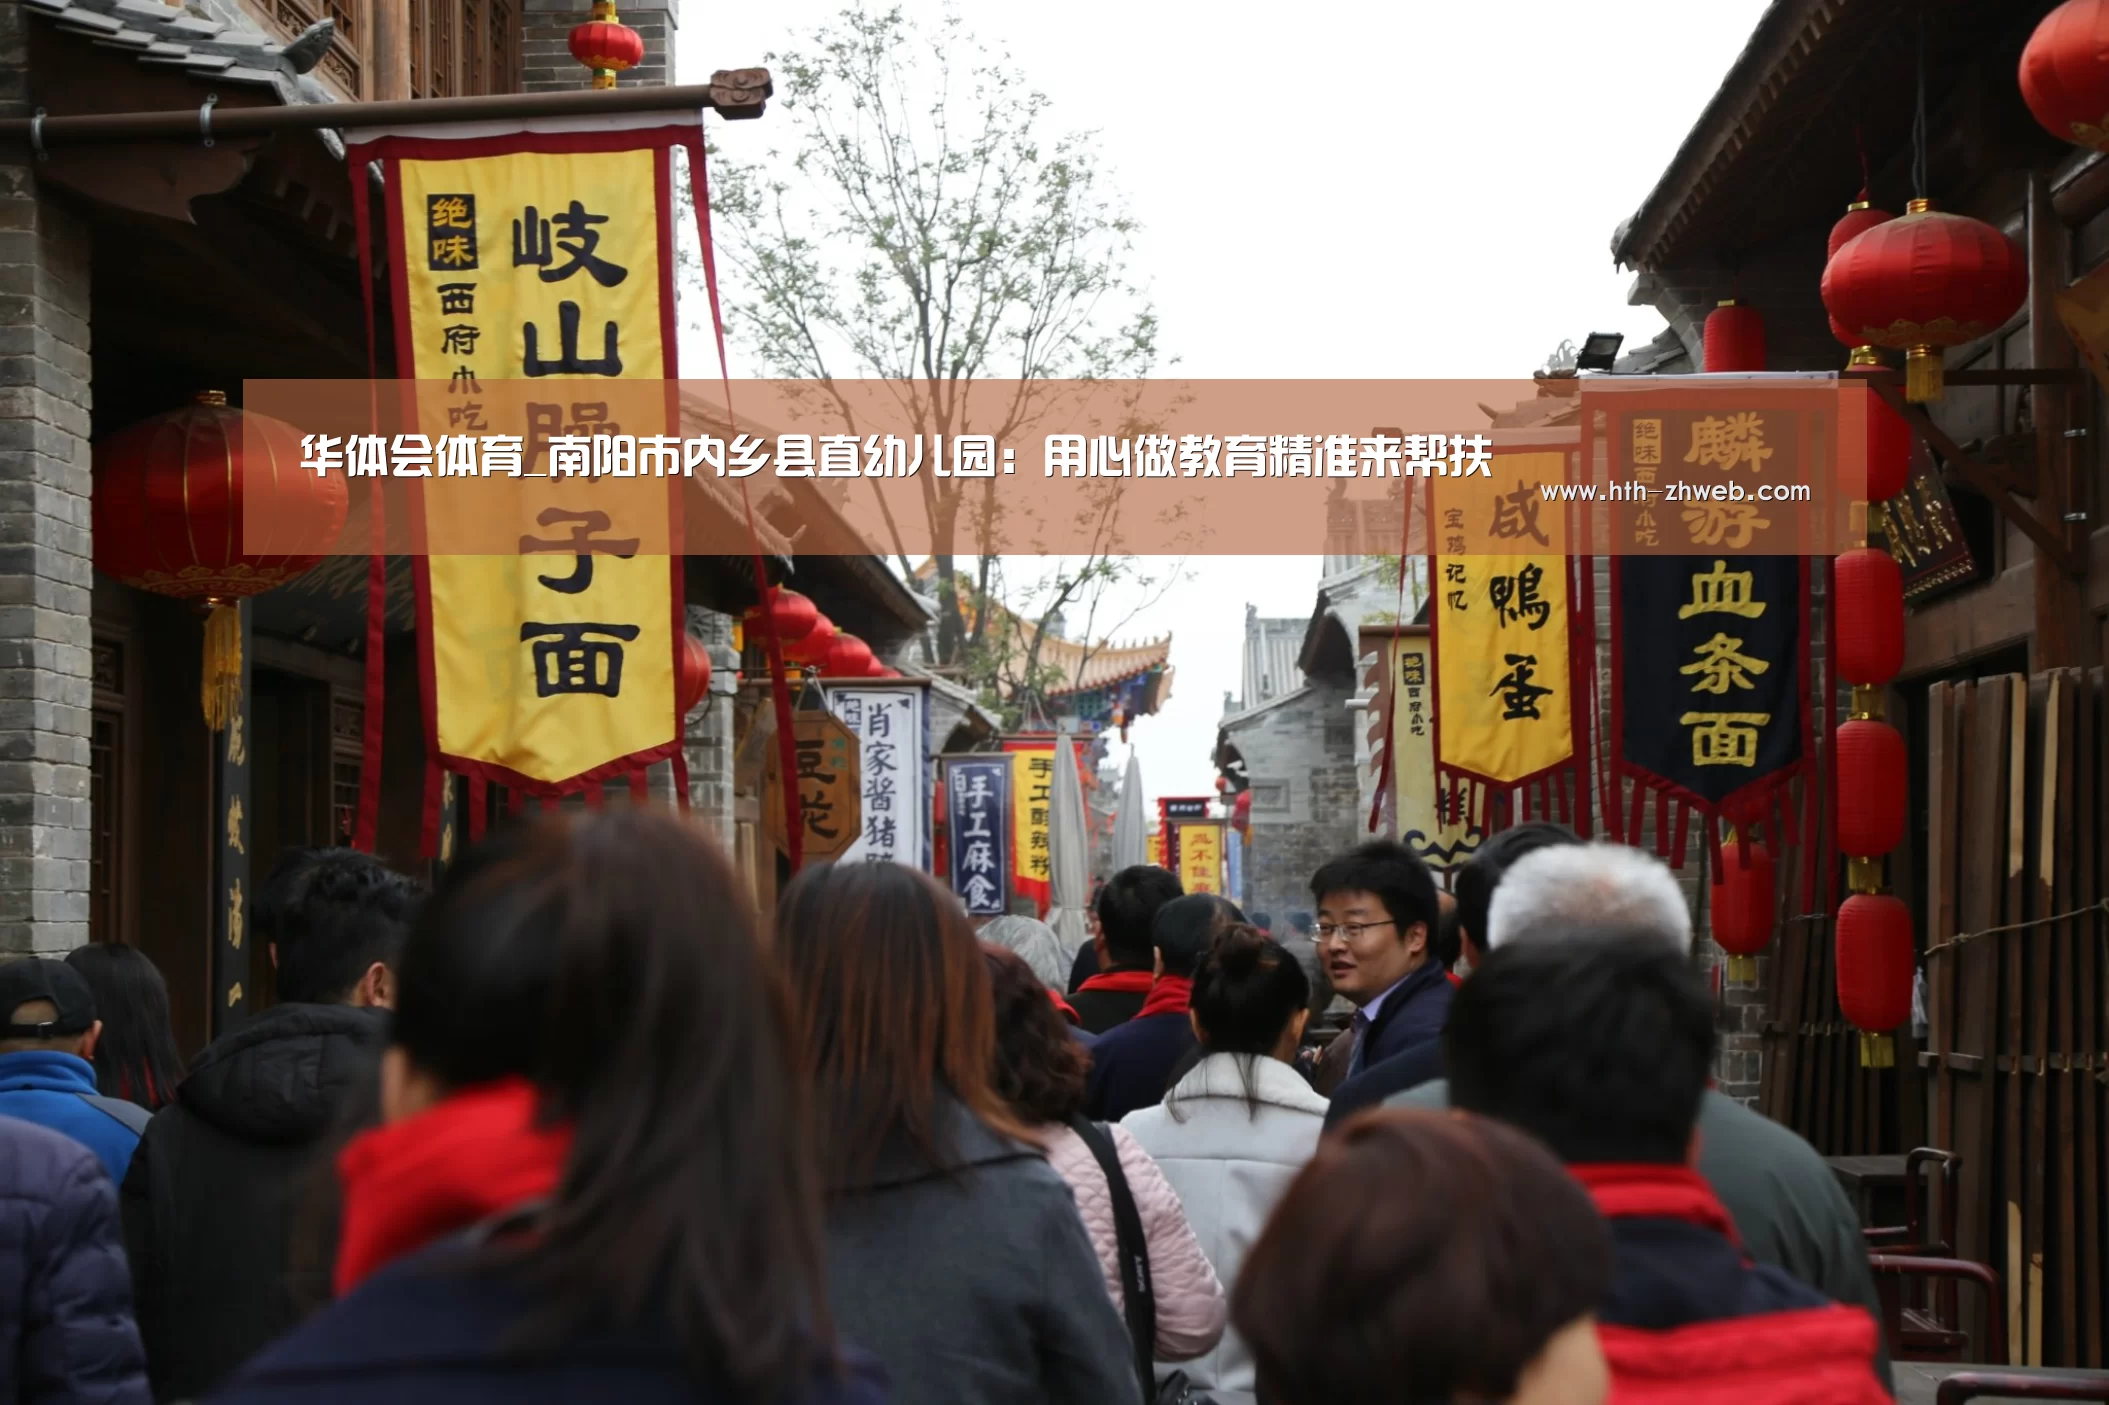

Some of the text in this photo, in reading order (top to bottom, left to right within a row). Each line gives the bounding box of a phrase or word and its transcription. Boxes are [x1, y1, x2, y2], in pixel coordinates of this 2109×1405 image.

[430, 196, 475, 268] 绝味
[436, 281, 488, 432] 西府小吃
[1635, 421, 1660, 461] 绝味
[962, 774, 997, 909] 手工麻食
